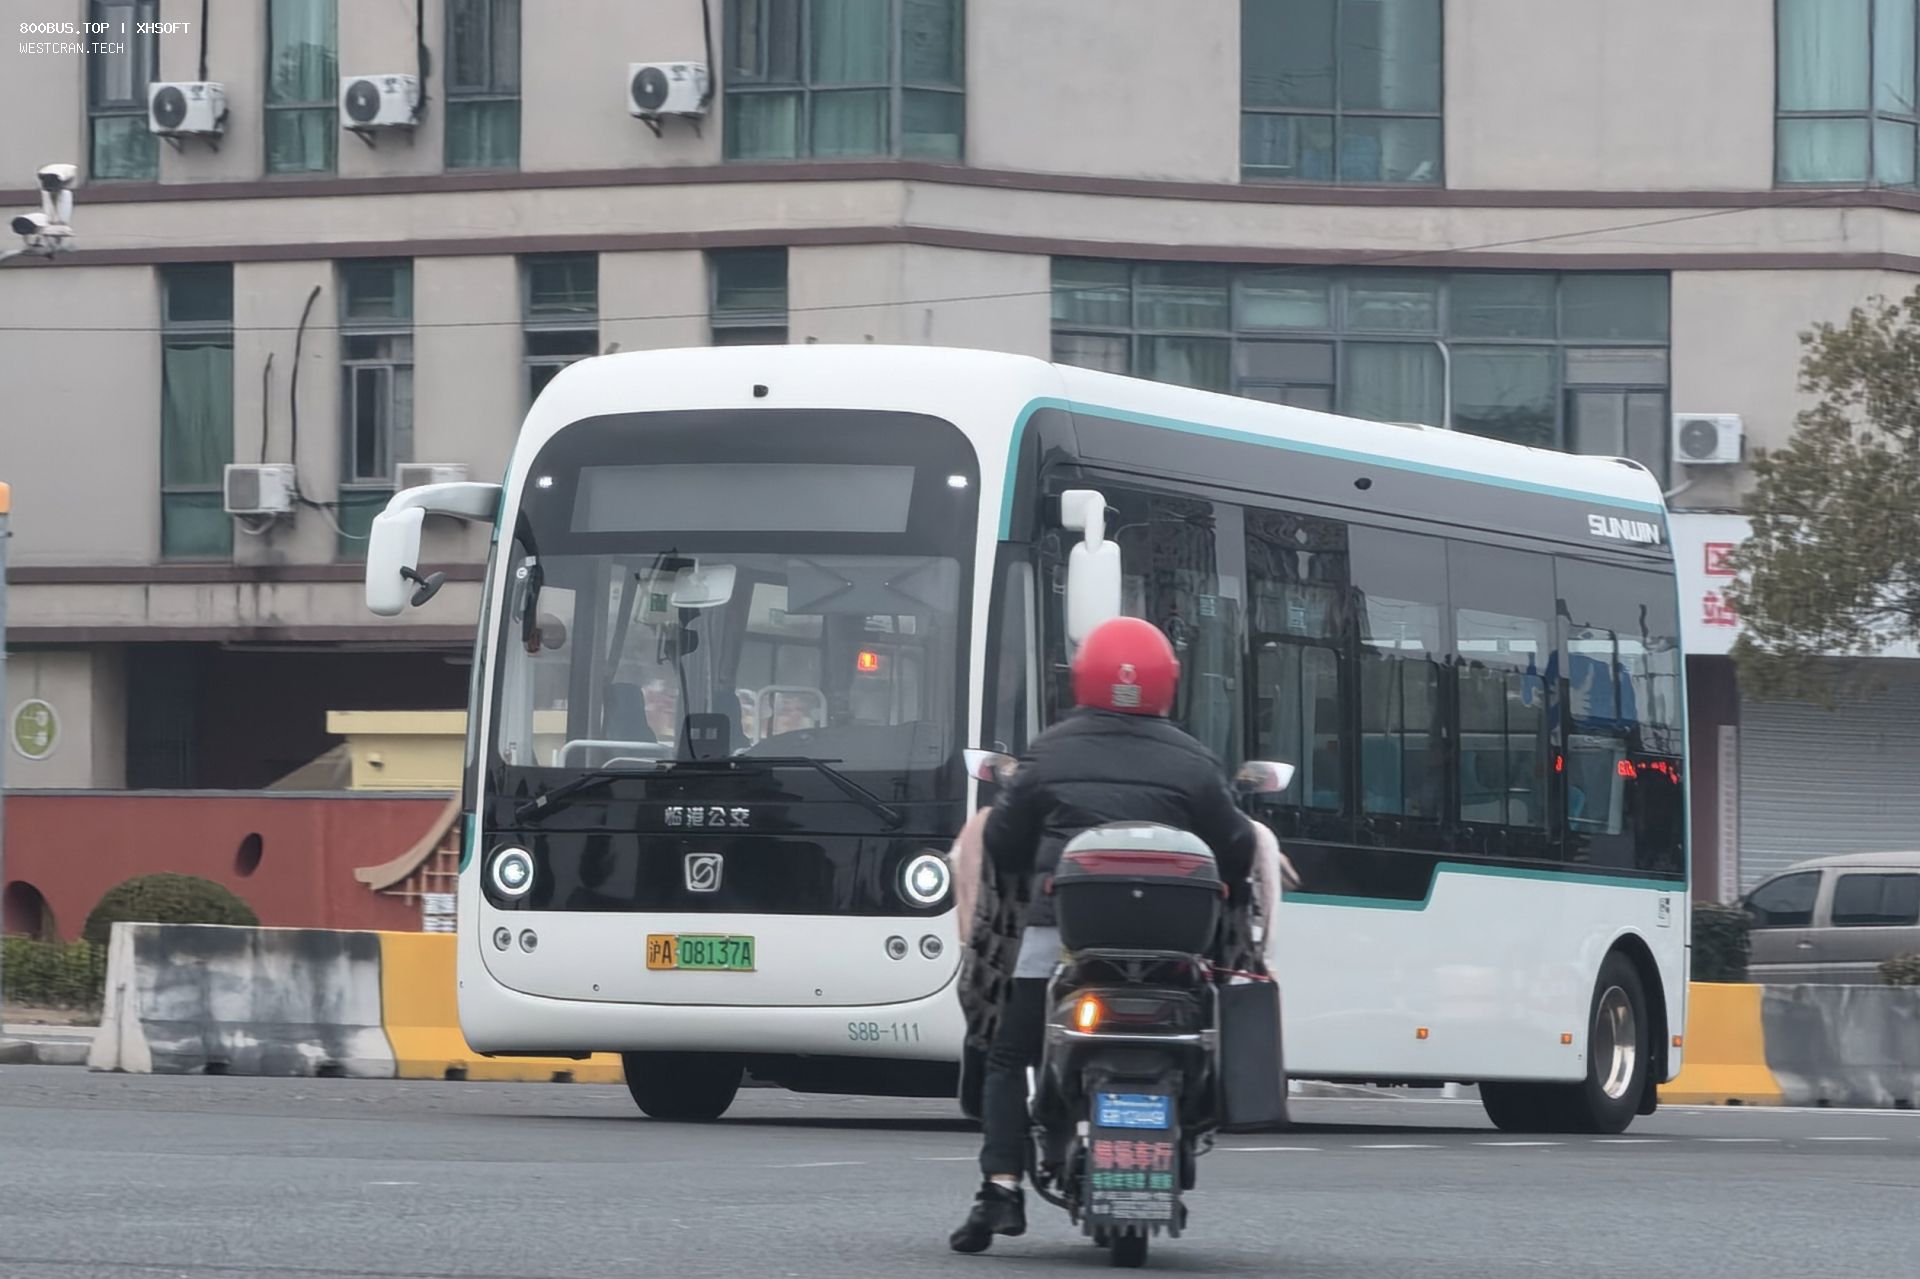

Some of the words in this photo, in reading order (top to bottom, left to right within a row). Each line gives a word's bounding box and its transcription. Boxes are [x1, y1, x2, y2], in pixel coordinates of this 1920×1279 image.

[1587, 514, 1660, 545] SUNWIN
[664, 806, 750, 827] 临港公交
[847, 1021, 920, 1042] S8B-111
